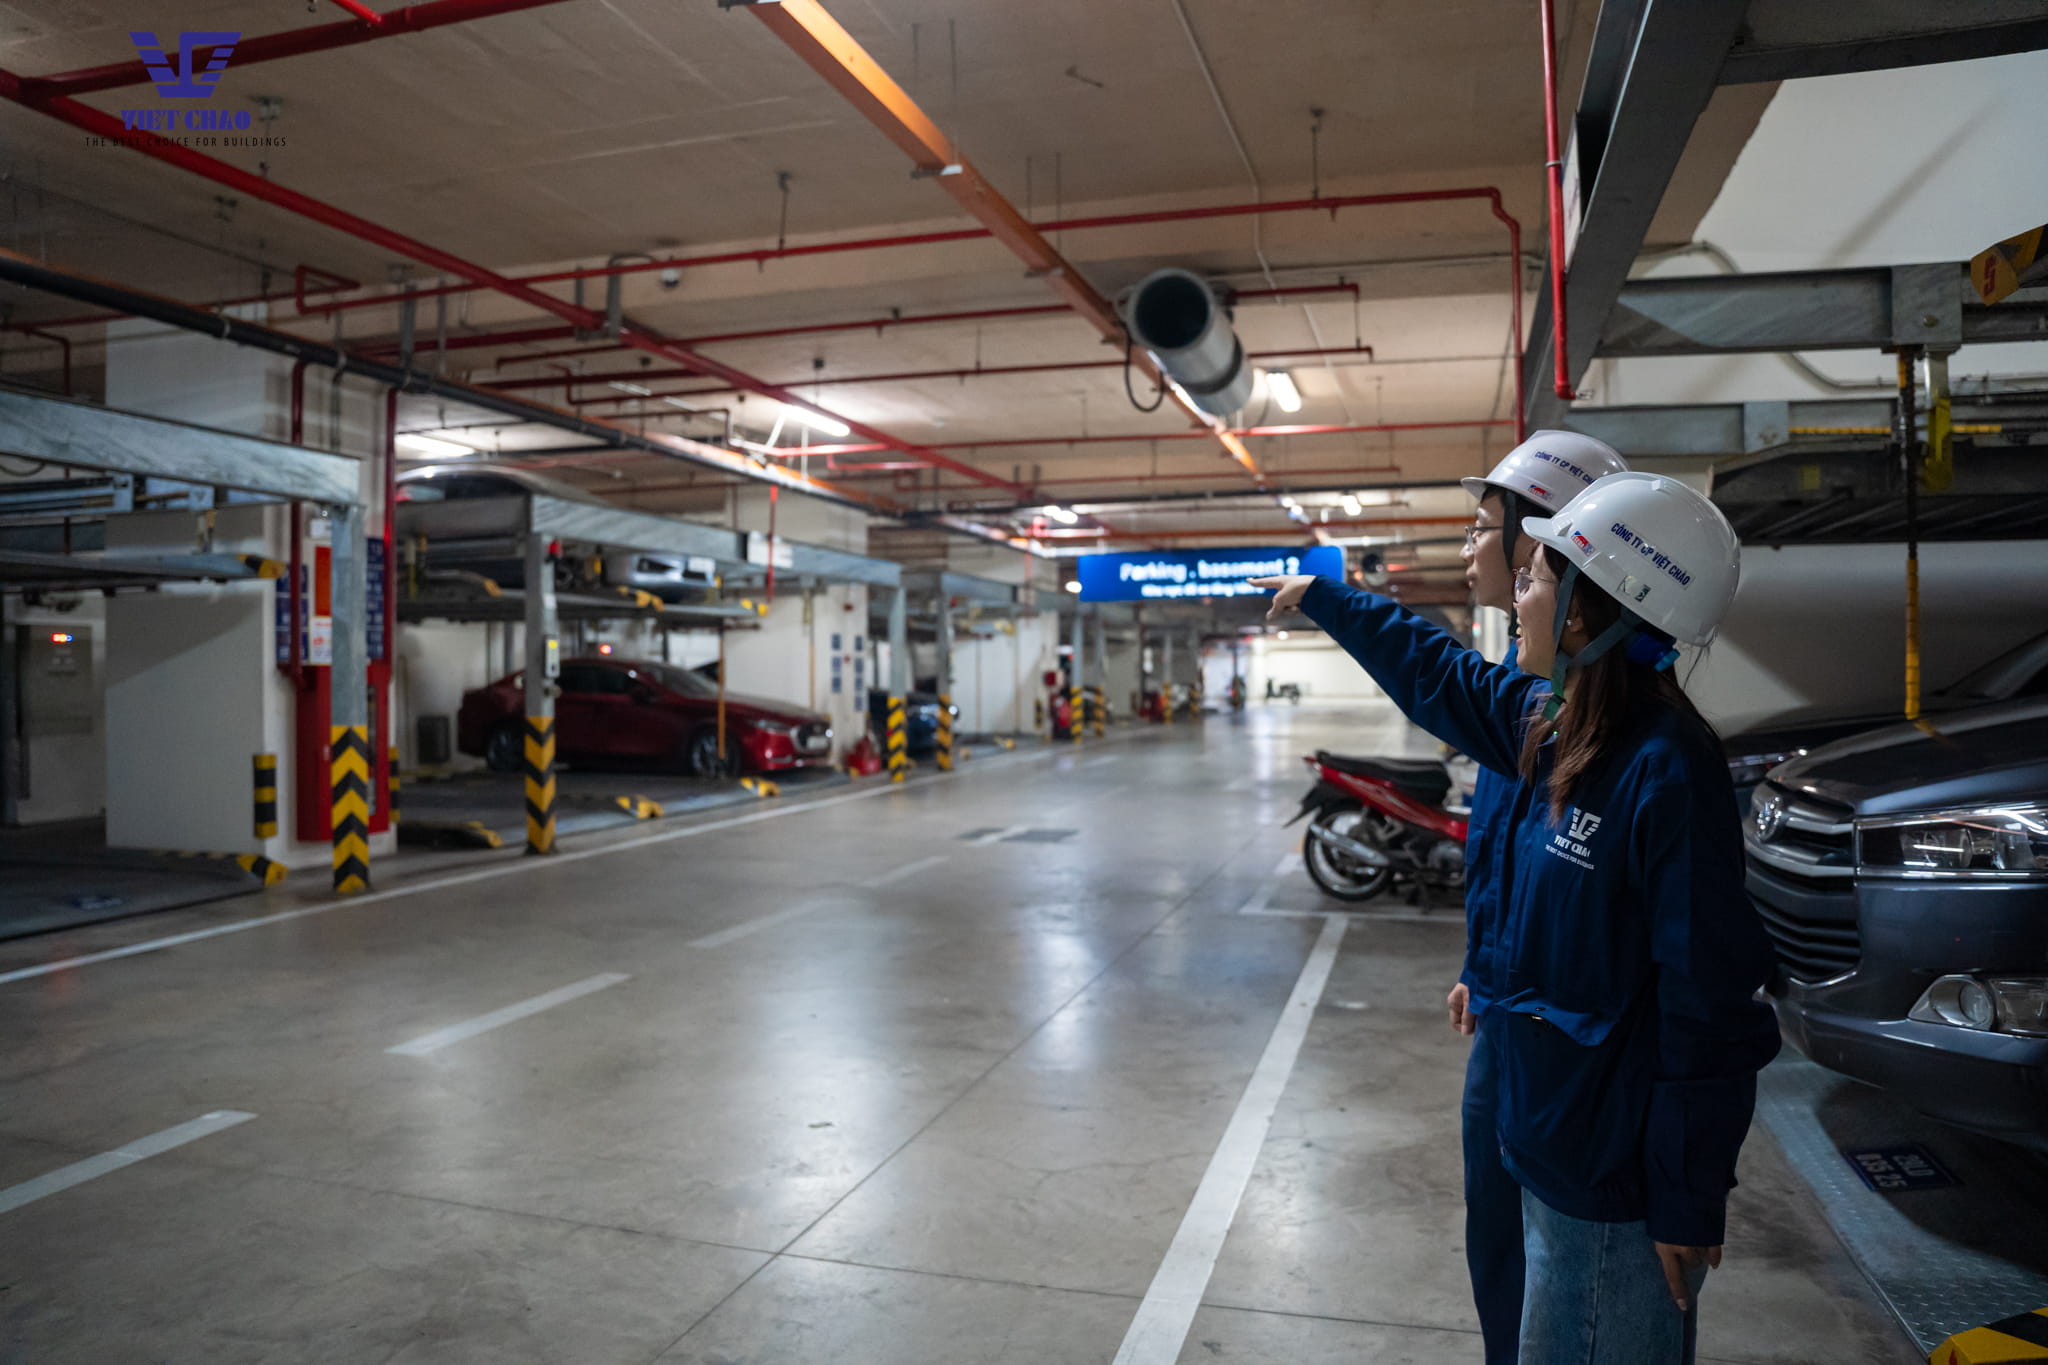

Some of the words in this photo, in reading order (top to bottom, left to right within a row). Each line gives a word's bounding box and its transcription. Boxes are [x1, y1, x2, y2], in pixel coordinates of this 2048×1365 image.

[1611, 522, 1633, 542] CÔNG
[1631, 536, 1644, 549] TY
[1640, 544, 1654, 556] CP
[1652, 552, 1672, 569] VIỆT
